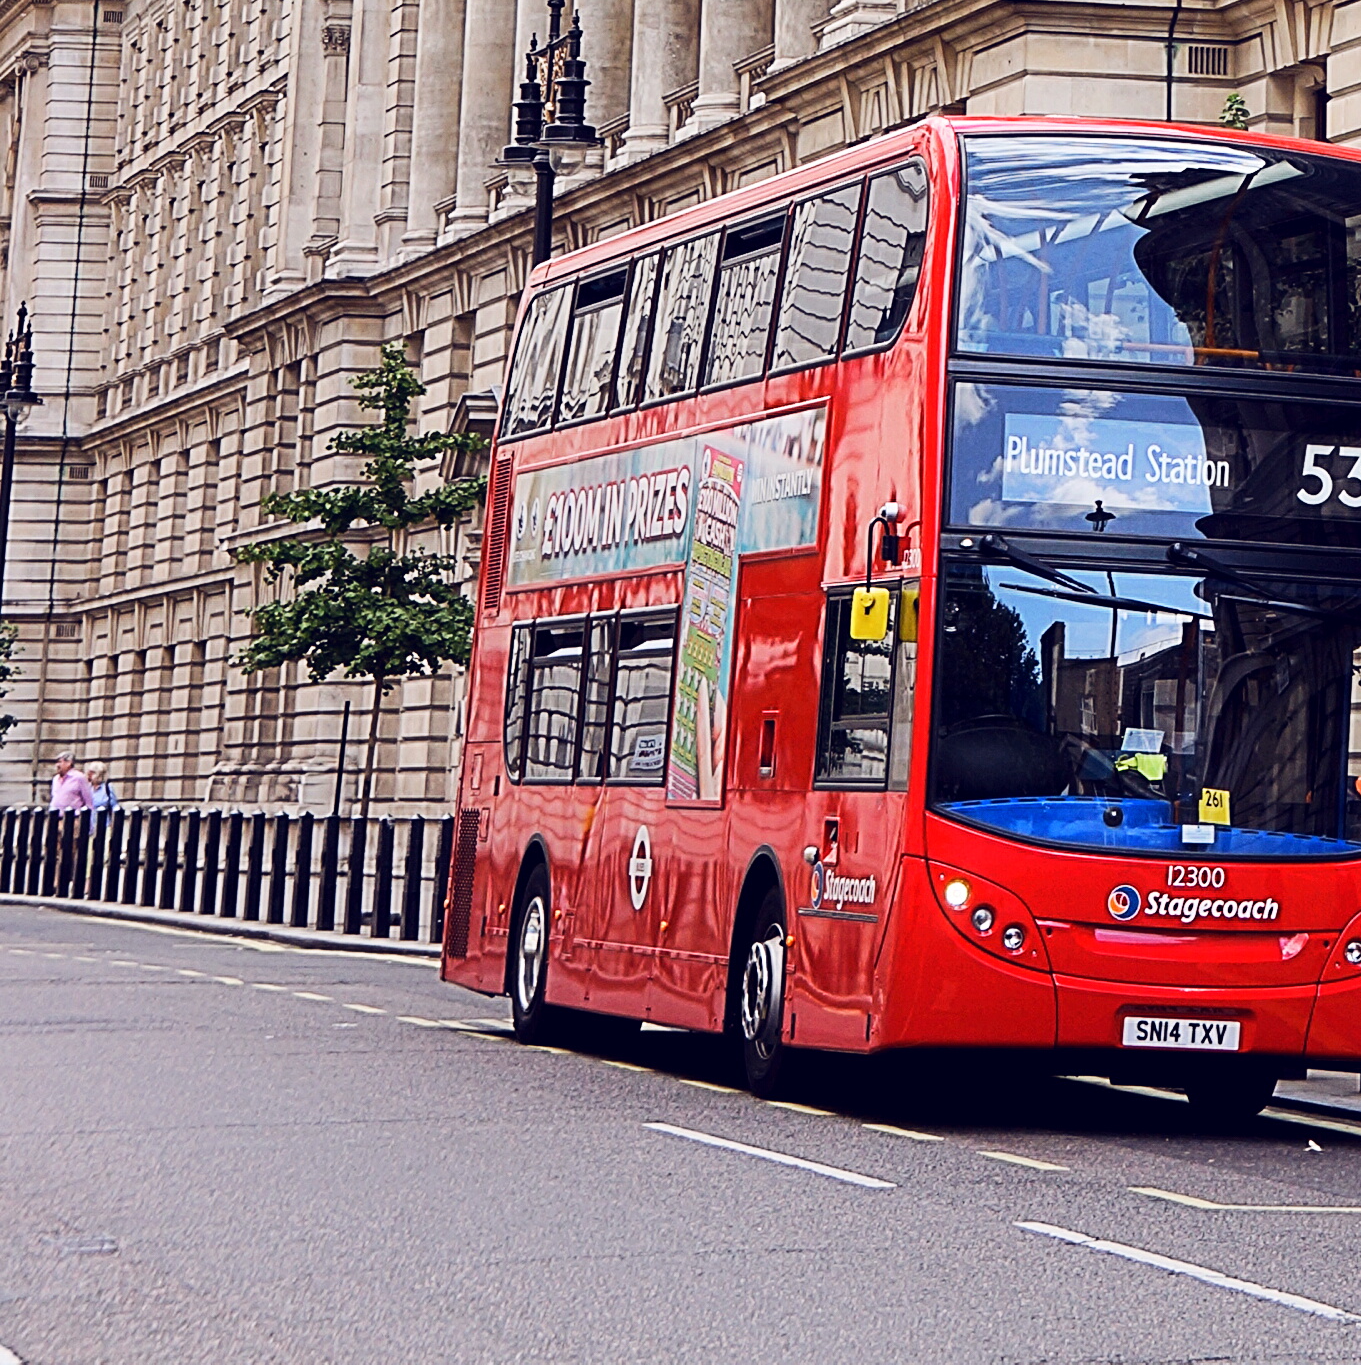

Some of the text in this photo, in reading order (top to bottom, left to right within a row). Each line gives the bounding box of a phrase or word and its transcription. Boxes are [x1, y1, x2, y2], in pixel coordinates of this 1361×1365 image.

[1006, 436, 1230, 487] Plumstead Station
[767, 468, 814, 501] INSTANTLY
[542, 466, 691, 558] £100M IN PRIZES
[1205, 790, 1223, 808] 261
[823, 869, 876, 910] Stagecoach
[1167, 865, 1225, 888] 12300
[1144, 891, 1279, 923] Stagecoach
[1136, 1020, 1227, 1045] SN14 TXV
